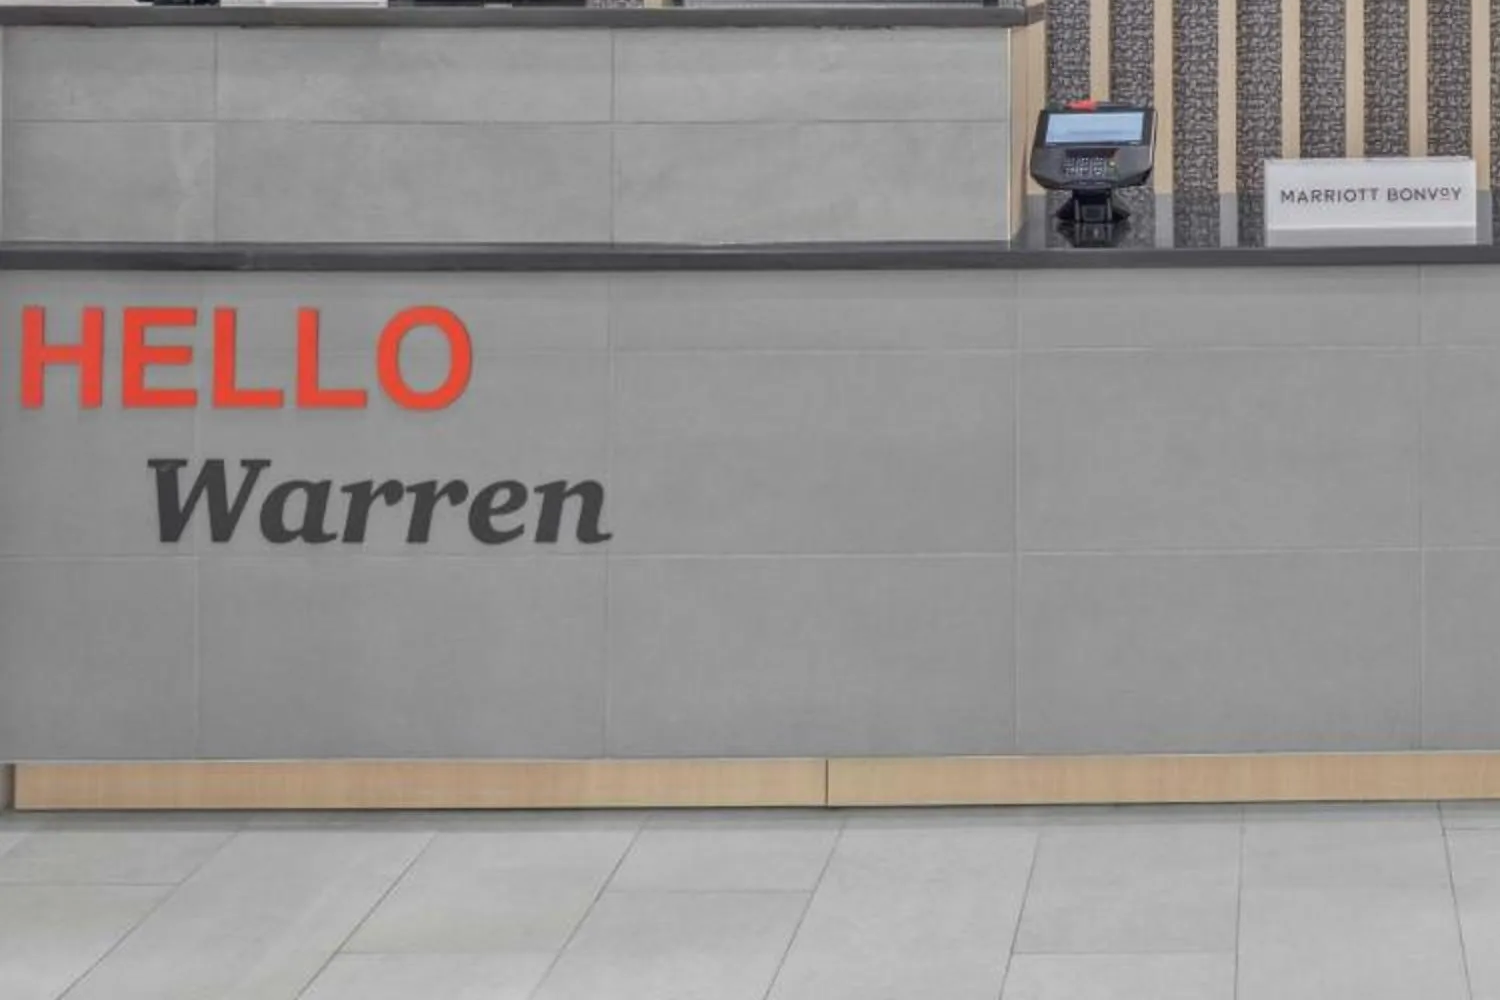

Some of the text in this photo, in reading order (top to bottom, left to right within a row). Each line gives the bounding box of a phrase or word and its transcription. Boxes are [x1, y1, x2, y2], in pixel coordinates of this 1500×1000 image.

[1280, 187, 1463, 204] MARRIOTT BONVOY
[21, 304, 474, 411] HELLO
[147, 458, 614, 545] Warren
